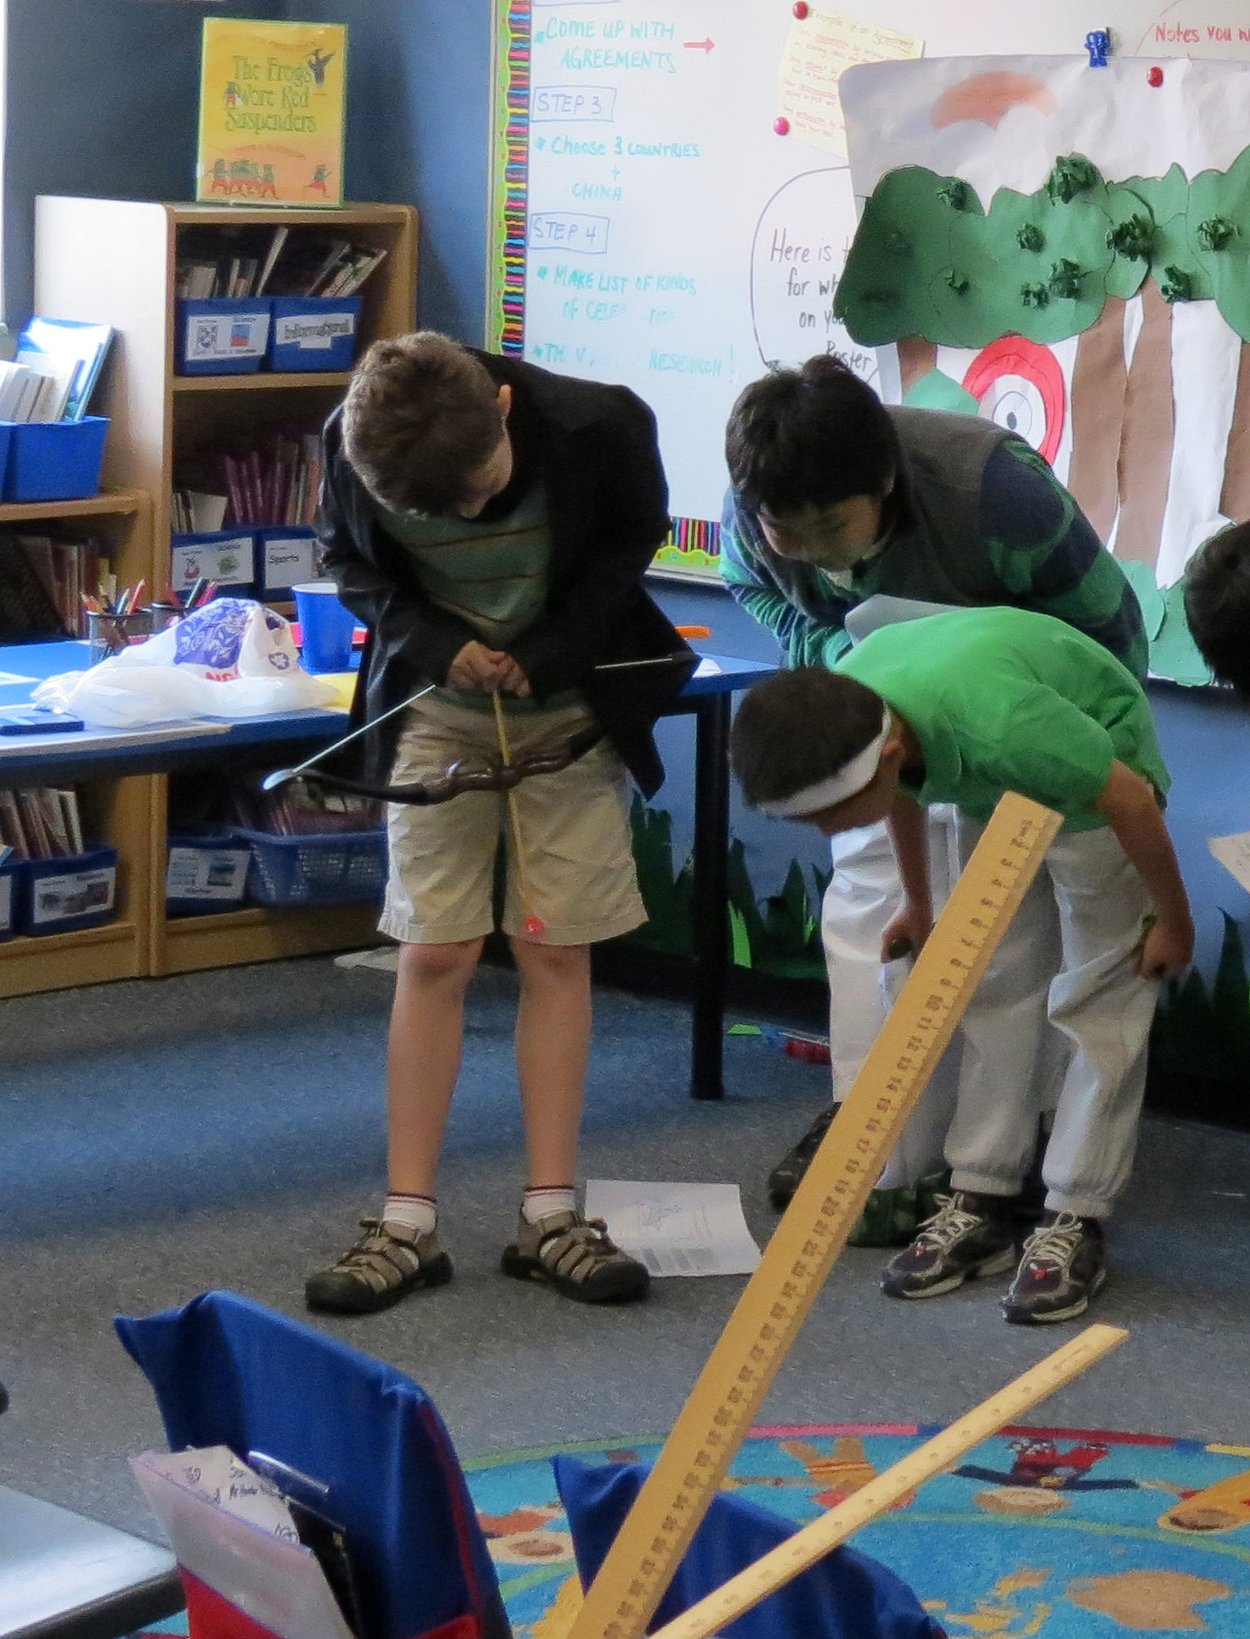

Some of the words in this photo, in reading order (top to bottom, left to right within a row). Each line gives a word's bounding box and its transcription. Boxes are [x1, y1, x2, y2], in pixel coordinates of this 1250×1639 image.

[546, 16, 596, 40] COME
[603, 19, 625, 38] UP
[630, 20, 676, 41] WITH
[1155, 21, 1200, 43] Notes
[1206, 25, 1232, 41] you
[233, 56, 260, 81] The
[267, 57, 312, 87] Frogs
[560, 46, 677, 74] AGREEMENTS
[537, 92, 584, 115] STEP
[590, 96, 602, 115] 3
[224, 107, 318, 135] Suspenders
[551, 135, 606, 156] Choose
[613, 136, 624, 156] 3
[628, 141, 702, 158] COUNTRIES
[571, 182, 623, 201] CHINA
[533, 217, 578, 242] STEP
[586, 226, 596, 246] 4
[770, 227, 811, 264] Here
[818, 245, 833, 262] is
[554, 264, 595, 290] MAKE
[598, 277, 630, 295] LIST
[635, 274, 653, 291] OF
[656, 272, 698, 297] KINDS
[787, 266, 811, 297] for
[563, 297, 579, 320] OF
[799, 312, 816, 328] on
[267, 552, 300, 569] Sports
